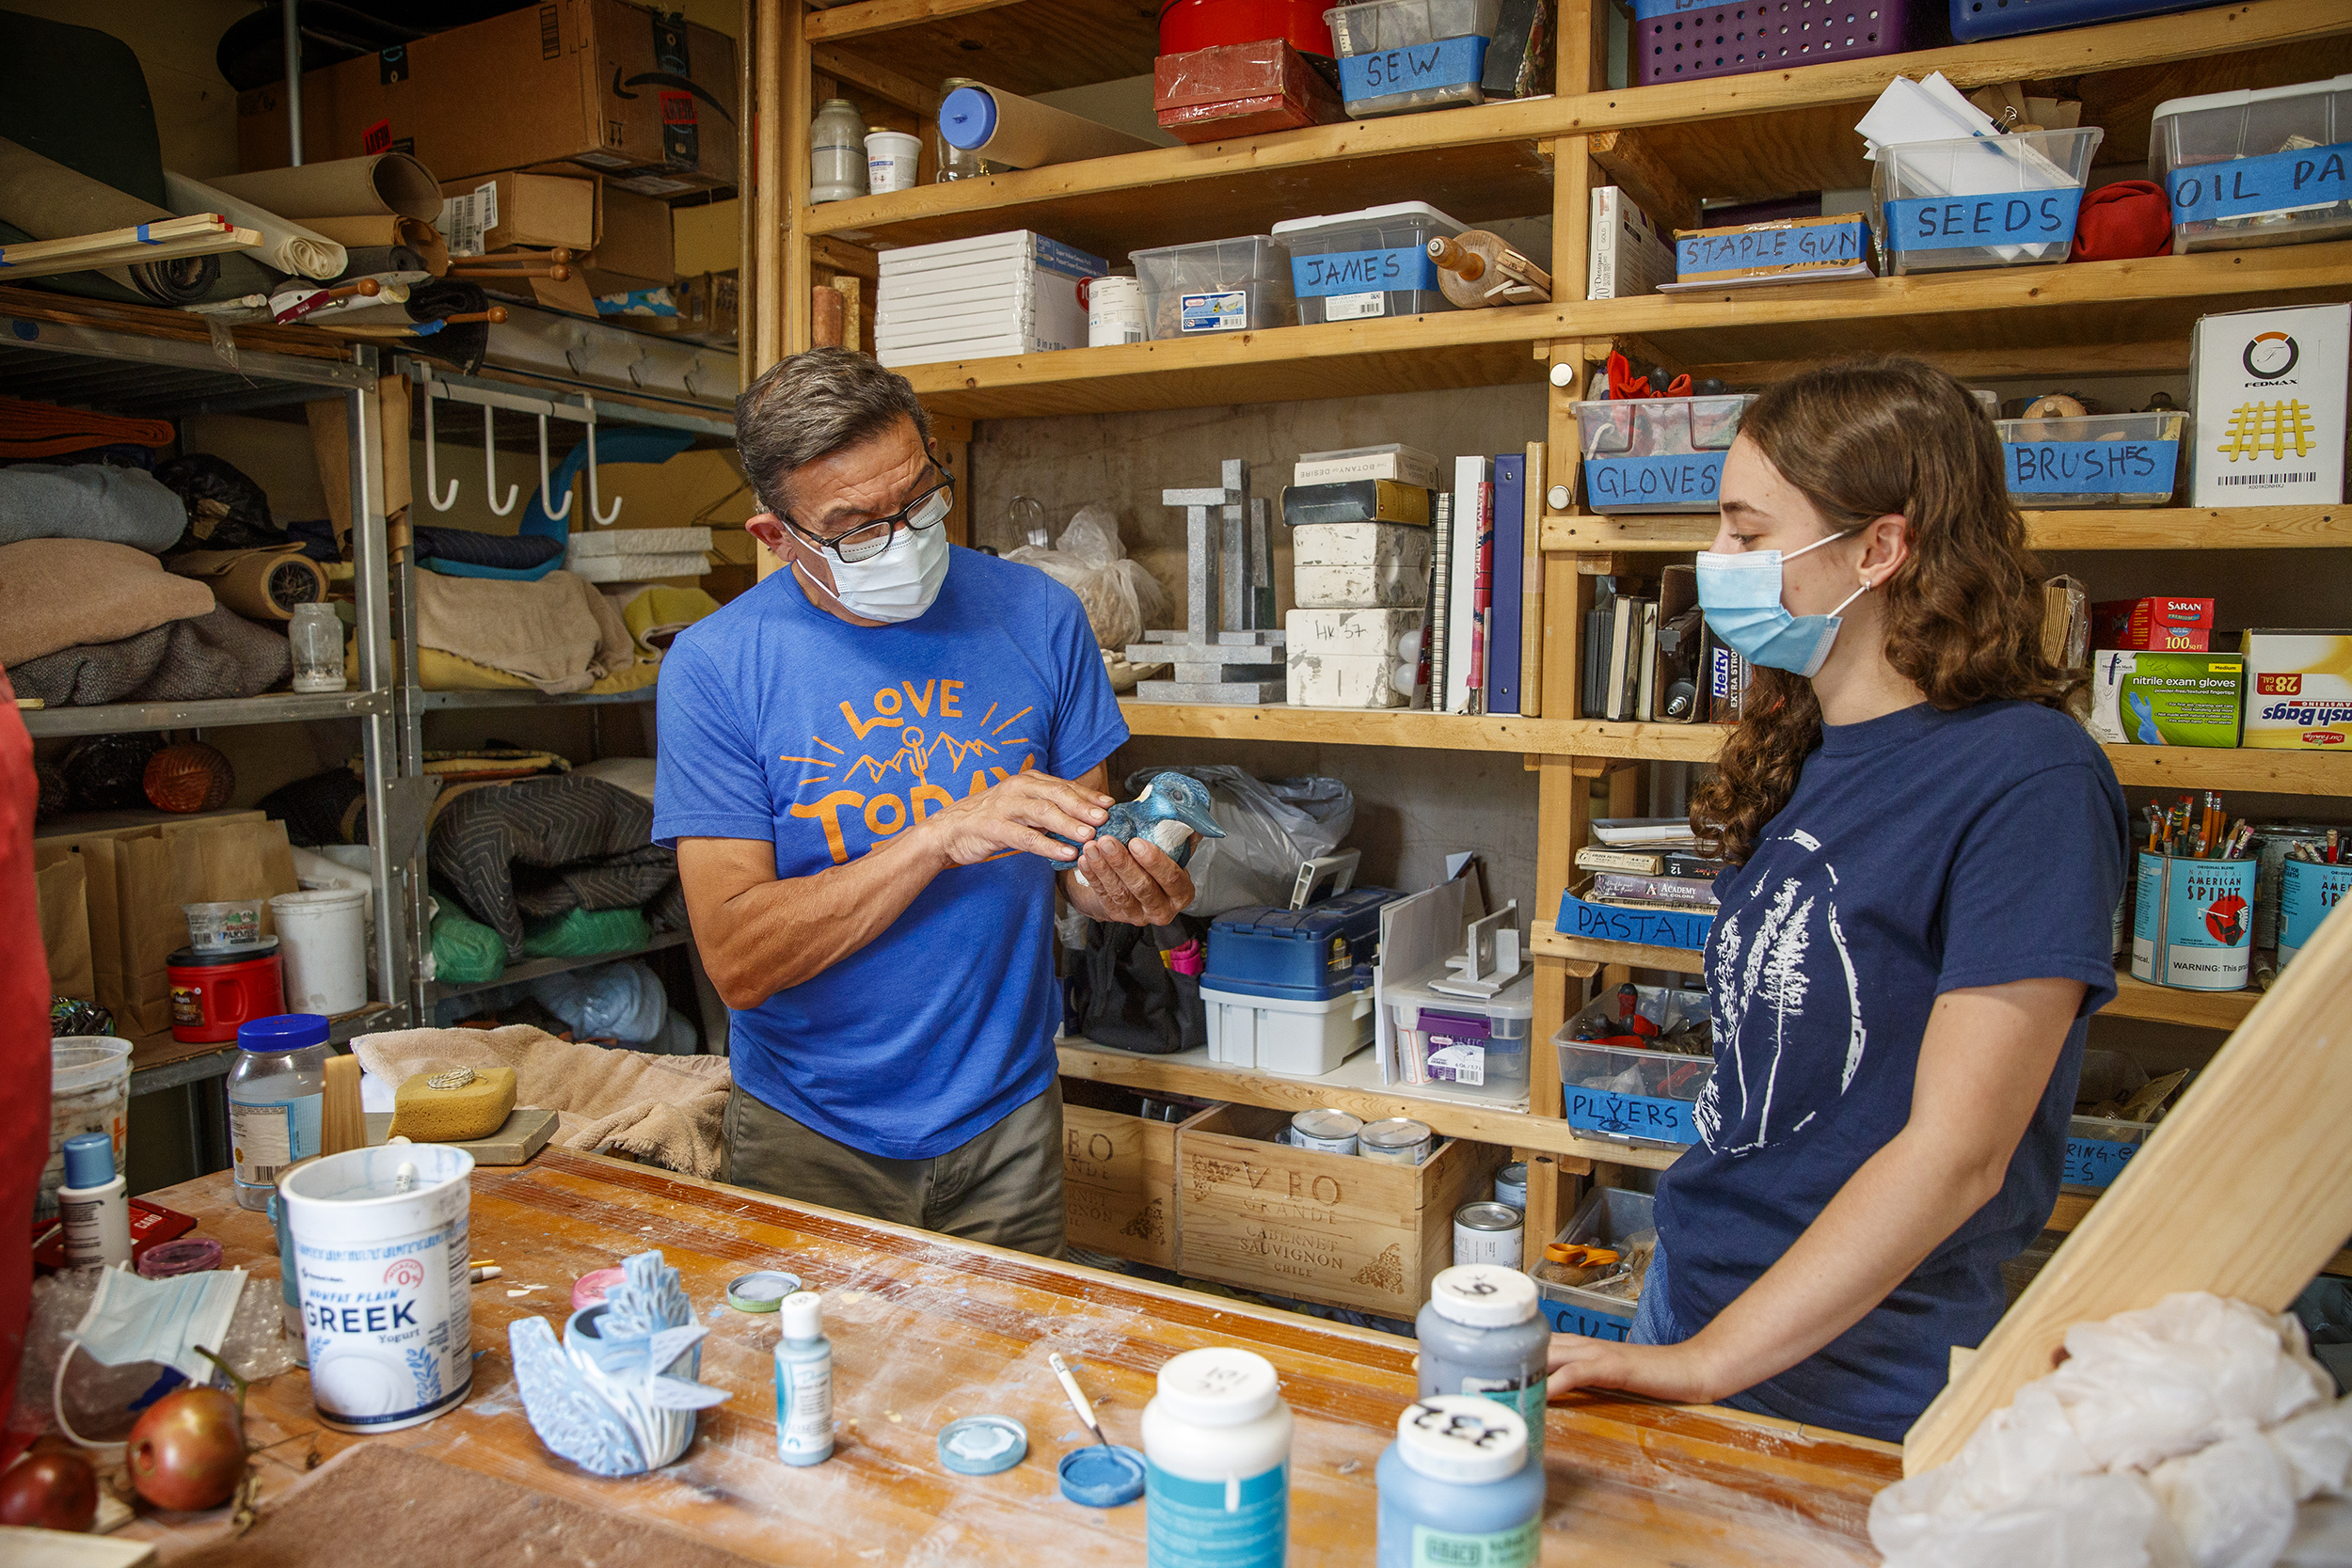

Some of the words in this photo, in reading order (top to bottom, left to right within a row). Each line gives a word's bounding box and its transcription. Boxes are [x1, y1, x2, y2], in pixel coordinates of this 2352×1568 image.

[1367, 46, 1440, 87] SEW
[2175, 172, 2261, 208] OIL
[1918, 198, 2062, 238] SEEDS
[1686, 231, 1788, 266] STAPLE
[1799, 230, 1857, 259] GUN
[1308, 254, 1400, 286] JAMES
[2244, 378, 2298, 388] FEDMAX
[1300, 467, 1330, 478] DESIRE
[1339, 463, 1375, 474] BOTANY
[2016, 445, 2154, 484] BRUSHES
[1597, 464, 1717, 499] GLOVES
[2168, 601, 2201, 611] SARAN
[2166, 637, 2190, 649] 100
[1714, 650, 1729, 696] Hefty
[2132, 675, 2164, 686] nitrile
[2166, 678, 2197, 687] exam
[2199, 677, 2236, 688] gloves
[2265, 684, 2274, 692] 30
[2275, 676, 2298, 692] 28
[839, 679, 964, 741] LOVE
[2262, 703, 2316, 726] Bags
[1671, 865, 1681, 876] 12
[2187, 876, 2242, 886] AMERICAN
[1661, 884, 1697, 895] ACADEMY
[2187, 885, 2241, 901] SPIRIT
[2173, 961, 2220, 973] WARNING:
[2223, 964, 2237, 973] This
[1573, 1095, 1678, 1128] PLYERS
[1243, 1199, 1338, 1225] GRANDE
[135, 1213, 163, 1229] CARD
[1246, 1225, 1338, 1252] CABERNET
[1240, 1238, 1343, 1270] SAUVIGNON
[1274, 1262, 1313, 1278] CHILE
[309, 1288, 351, 1303] NONFAT
[356, 1289, 400, 1303] PLAIN
[305, 1299, 418, 1334] GREEK
[378, 1328, 421, 1344] Yogurt
